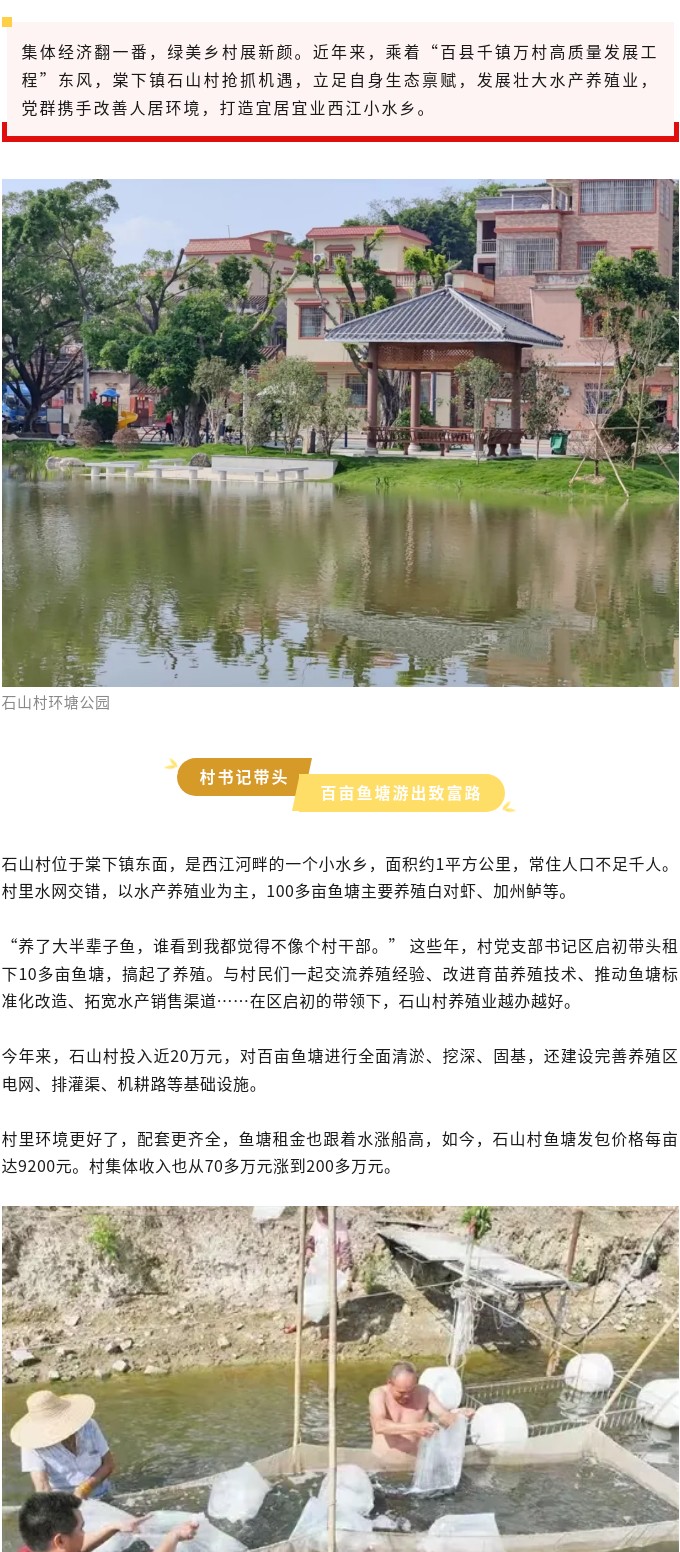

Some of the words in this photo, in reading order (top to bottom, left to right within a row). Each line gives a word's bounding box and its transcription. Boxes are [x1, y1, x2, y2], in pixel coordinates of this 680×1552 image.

[22, 44, 656, 60] 集体经济翻一番，绿美乡村展新颜。近年来，乘着“百县千镇万村高质量发展工
[22, 72, 648, 88] 程”东风，棠下镇石山村抢抓机遇，立足自身生态禀赋，发展壮大水产养殖业，
[22, 100, 425, 116] 党群携手改善人居环境，打造宜居宜业西江小水乡。
[200, 769, 288, 785] 村书记带头
[321, 785, 480, 801] 百亩鱼塘游出致富路
[2, 856, 670, 872] 石山村位于棠下镇东面，是西江河畔的一个小水乡，面积约1平方公里，常住人口不足千人。
[2, 883, 567, 899] 村里水网交错，以水产养殖业为主，100多亩鱼塘主要养殖白对虾、加州鲈等。
[2, 966, 677, 982] 下10多亩鱼塘，搞起了养殖。与村民们一起交流养殖经验、改进育苗养殖技术、推动鱼塘标
[2, 993, 571, 1009] 准化改造、拓宽水产销售渠道……在区启初的带领下，石山村养殖业越办越好。
[2, 1048, 677, 1064] 今年来，石山村投入近20万元，对百亩鱼塘进行全面清淤、挖深、固基，还建设完善养殖区
[3, 1076, 256, 1092] 电网、排灌渠、机耕路等基础设施。
[2, 1131, 677, 1147] 村里环境更好了，配套更齐全，鱼塘租金也跟着水涨船高，如今，石山村鱼塘发包价格每亩
[2, 1158, 391, 1174] 达9200元。村集体收入也从70多万元涨到200多万元。
